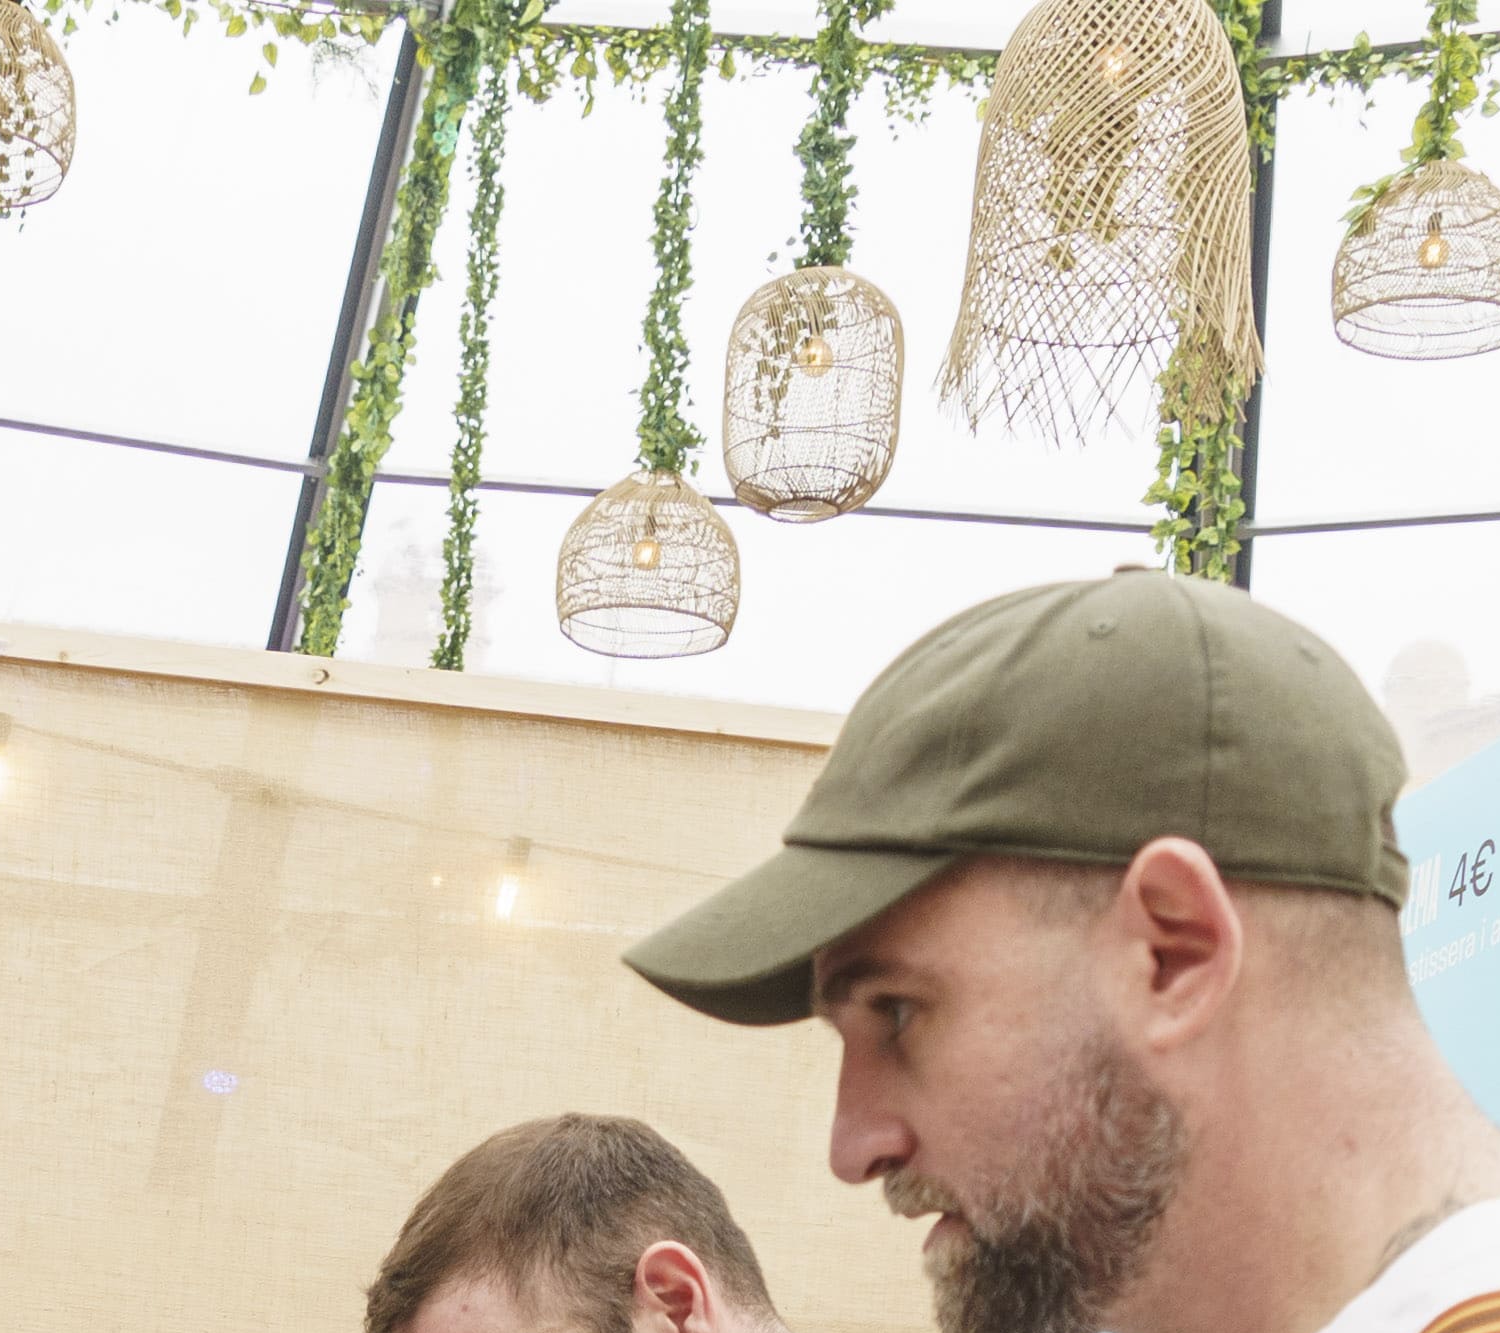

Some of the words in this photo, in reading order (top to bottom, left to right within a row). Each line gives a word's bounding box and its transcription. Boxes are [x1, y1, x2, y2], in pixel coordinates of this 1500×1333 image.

[1402, 852, 1441, 936] EMA
[1447, 838, 1497, 908] 4€
[1480, 916, 1488, 953] i
